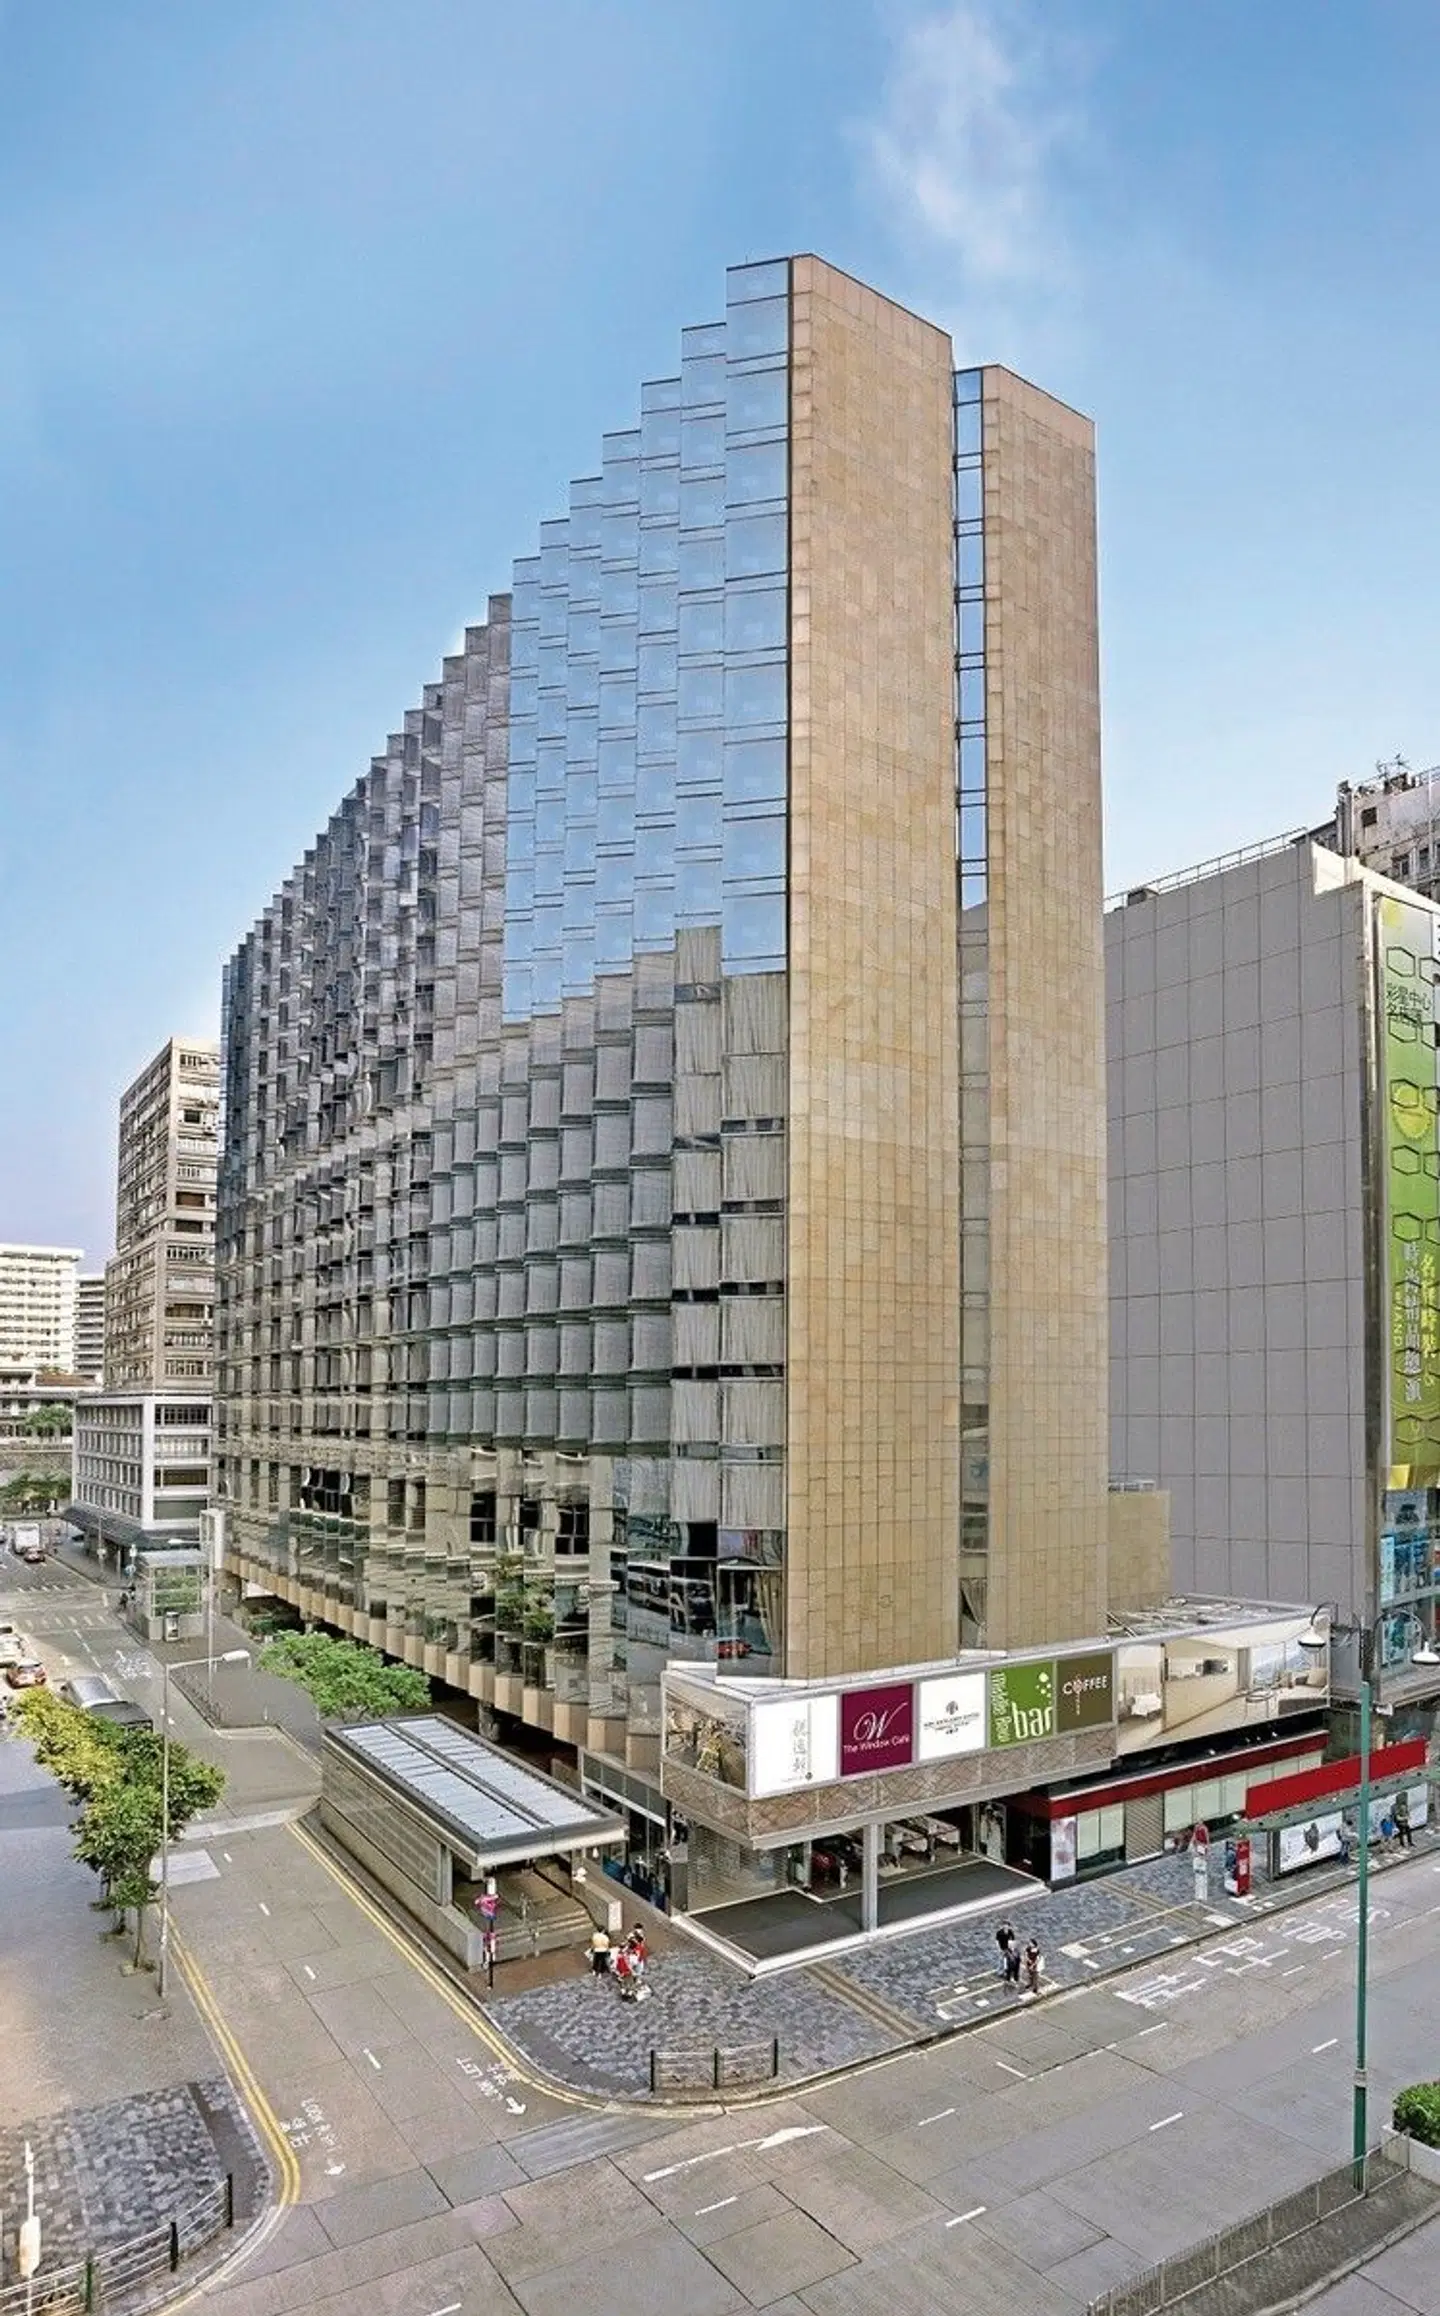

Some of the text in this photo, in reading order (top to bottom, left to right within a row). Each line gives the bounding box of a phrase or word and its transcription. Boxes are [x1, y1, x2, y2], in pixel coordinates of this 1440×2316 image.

[1062, 1675, 1108, 1695] COFFEE
[1011, 1701, 1053, 1739] bar
[843, 1744, 859, 1755] The
[860, 1739, 890, 1751] Window
[1191, 1937, 1290, 1976] 巴士
